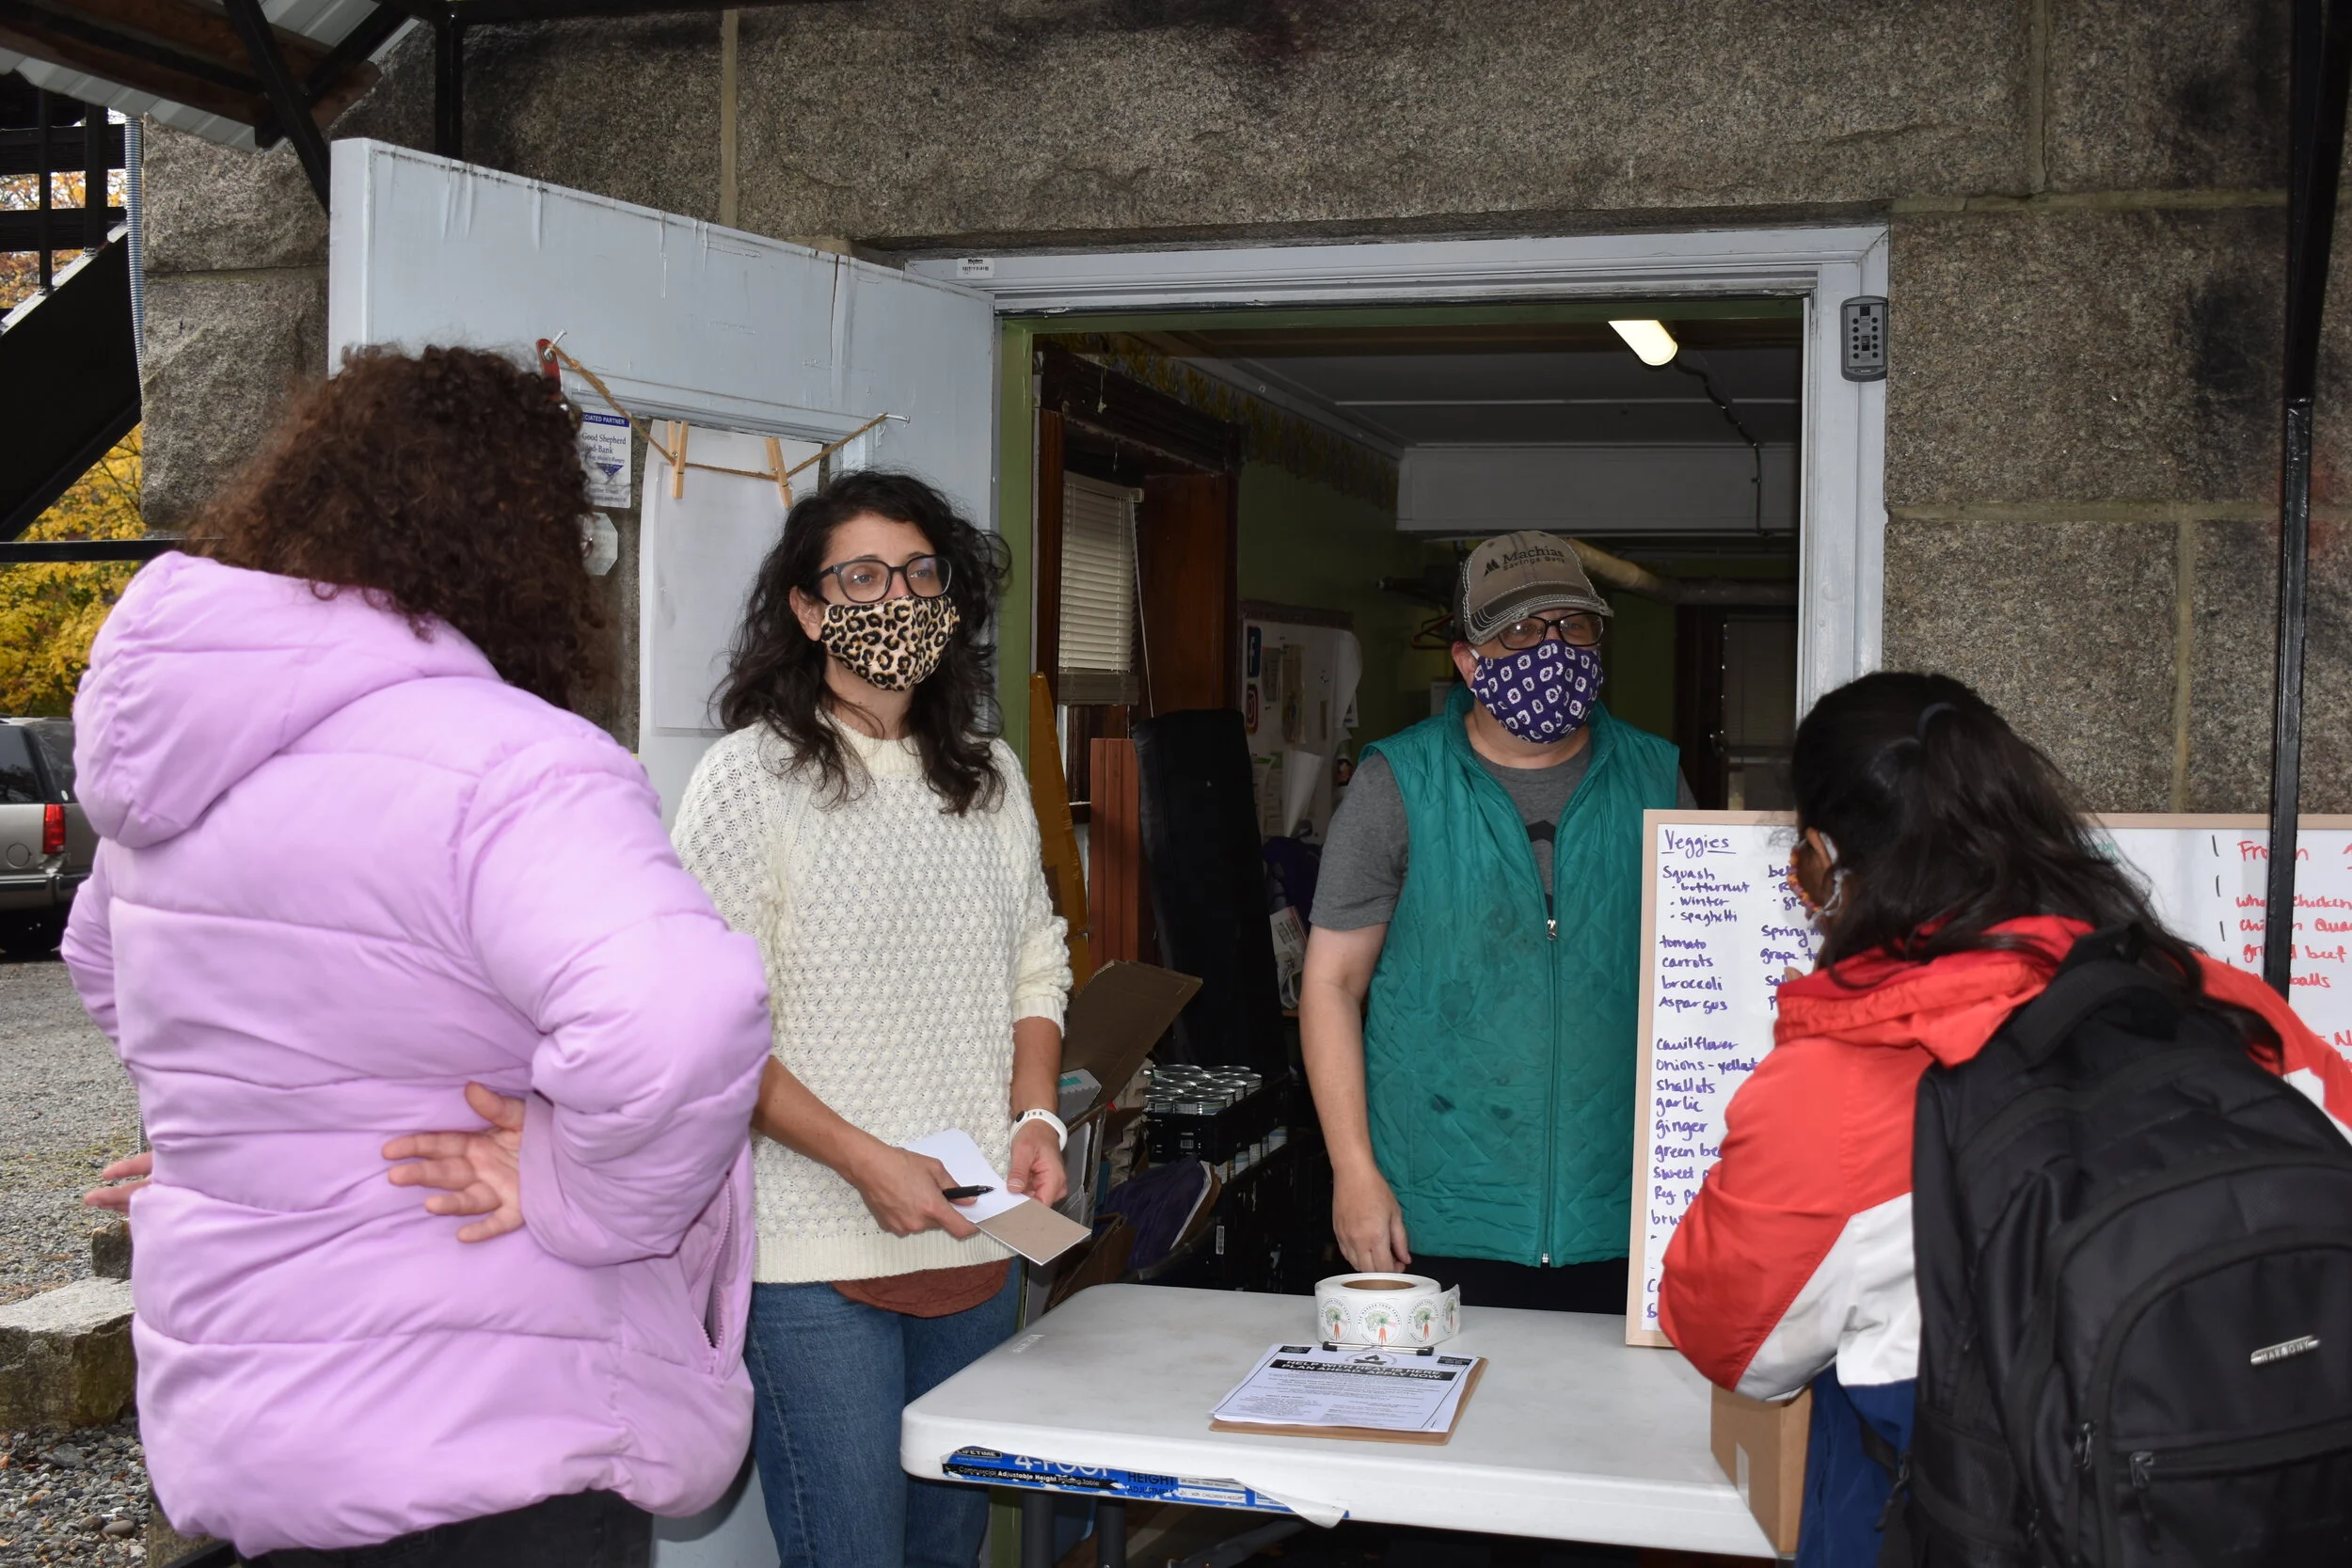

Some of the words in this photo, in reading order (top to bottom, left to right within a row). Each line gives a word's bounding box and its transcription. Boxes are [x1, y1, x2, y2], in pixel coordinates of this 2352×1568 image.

[582, 433, 597, 441] Good
[598, 435, 626, 445] Shepherd
[1502, 546, 1564, 563] Machias
[1665, 829, 1729, 858] Veggies
[2237, 840, 2309, 862] Fron
[1659, 935, 1707, 949] tomato
[1662, 954, 1713, 968] carrots
[1661, 974, 1723, 990] broccoli
[1656, 1096, 1704, 1117] garlic
[1656, 1119, 1708, 1141] ginger
[1655, 1144, 1695, 1163] green
[959, 1466, 996, 1476] Commercial
[997, 1470, 1034, 1481] Adjustable
[1035, 1474, 1057, 1482] Height
[1128, 1472, 1174, 1485] HEIGHT
